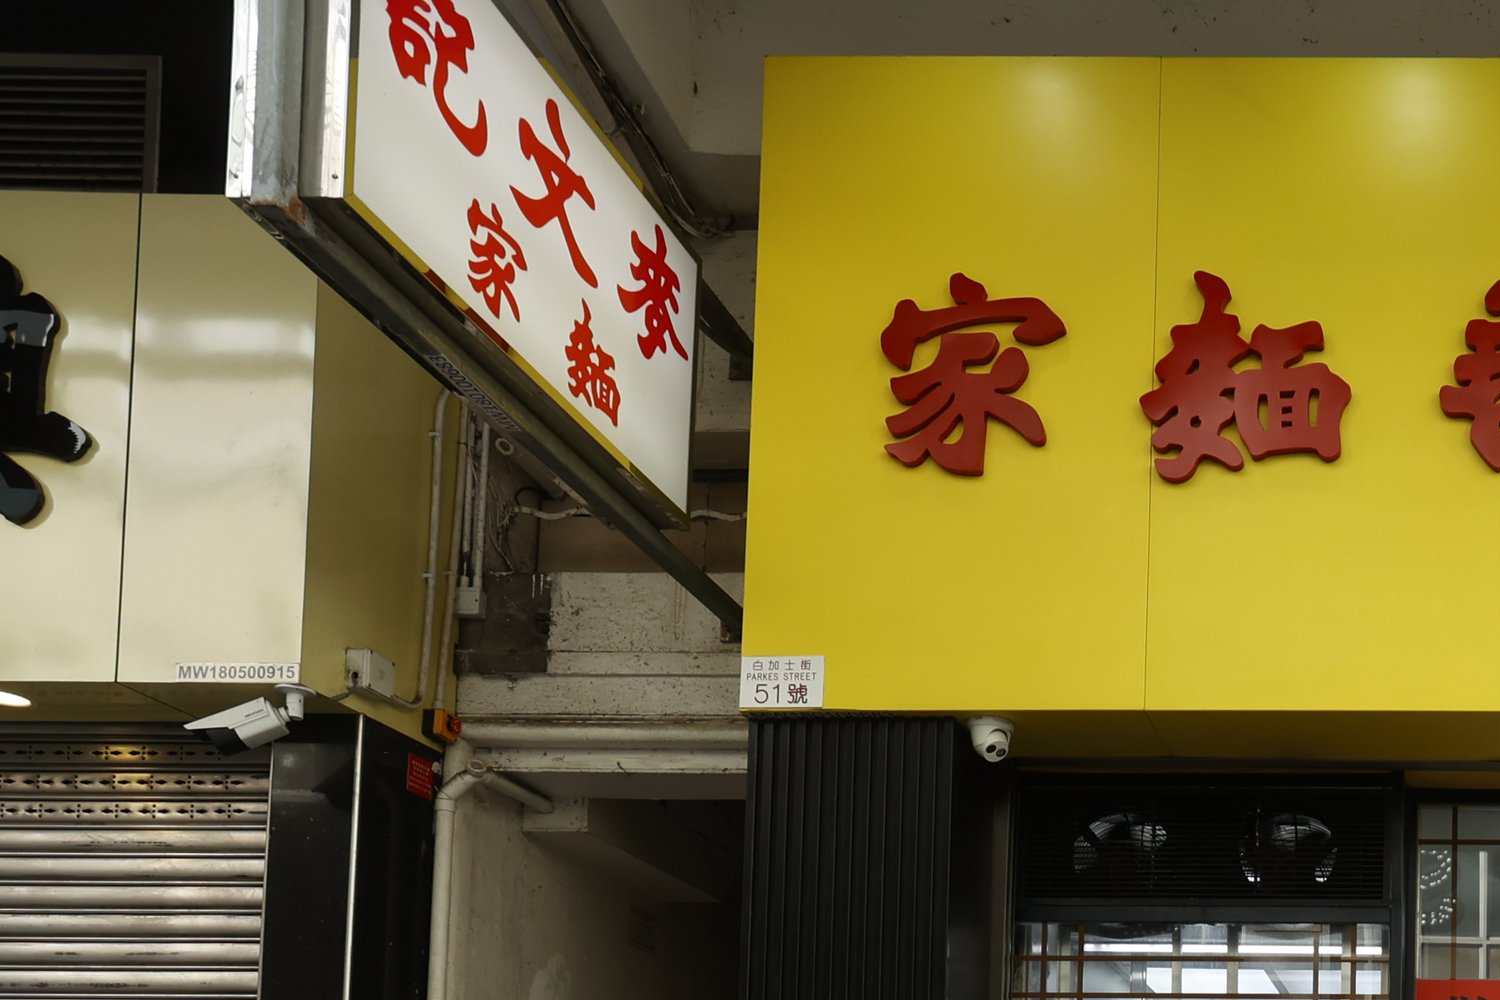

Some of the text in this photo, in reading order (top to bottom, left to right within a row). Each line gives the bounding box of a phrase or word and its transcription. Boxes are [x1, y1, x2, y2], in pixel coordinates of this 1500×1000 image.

[752, 659, 811, 671] 白加士街
[178, 665, 296, 679] MW180500915
[746, 672, 817, 681] PARKES STREET
